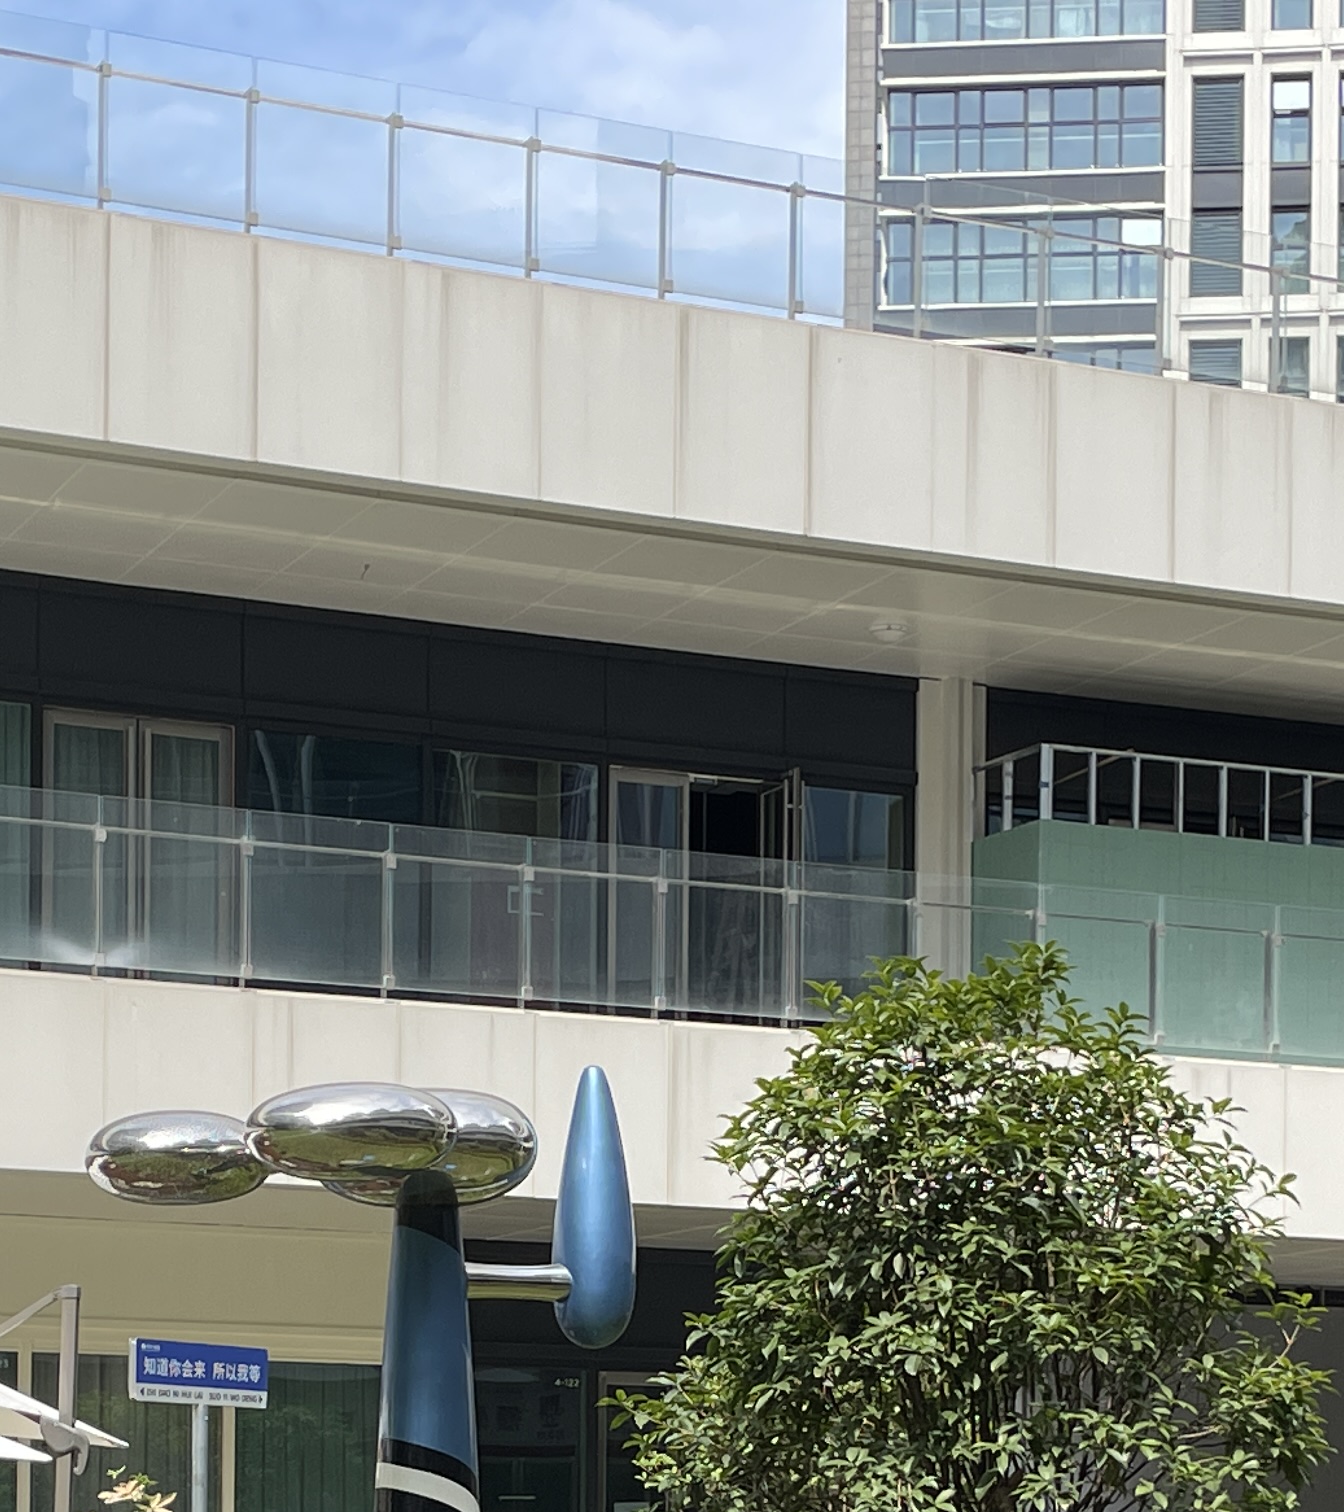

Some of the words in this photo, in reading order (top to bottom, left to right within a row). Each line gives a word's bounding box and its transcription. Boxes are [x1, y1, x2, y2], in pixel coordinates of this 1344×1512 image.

[143, 1355, 206, 1379] 知道你会来
[212, 1362, 261, 1384] 所以我等
